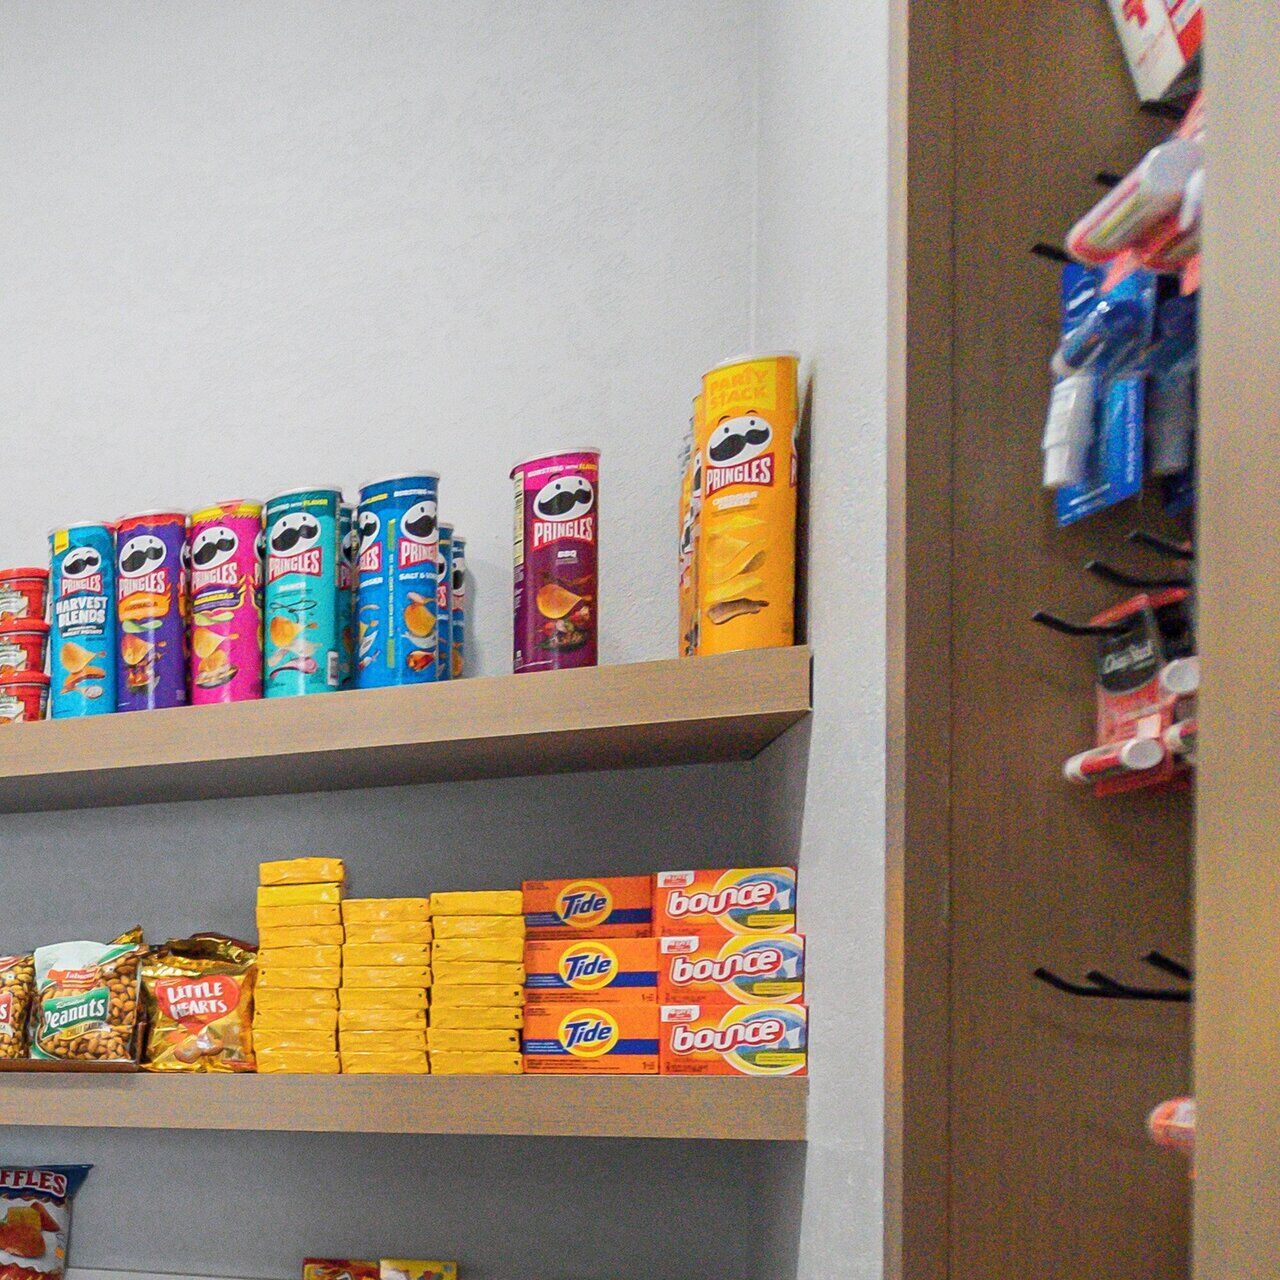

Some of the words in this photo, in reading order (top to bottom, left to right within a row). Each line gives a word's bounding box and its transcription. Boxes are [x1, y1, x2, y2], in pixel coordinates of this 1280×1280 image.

[707, 457, 771, 494] PRINGLES
[534, 518, 593, 546] PRINGLES
[192, 564, 237, 587] PRINGLES
[269, 550, 321, 574] PRINGLES
[62, 577, 102, 593] PRINGLES
[118, 572, 165, 594] PRINGLES
[57, 596, 107, 614] HARVEST
[59, 609, 105, 624] BLENDS
[562, 893, 607, 920] Tide
[669, 884, 773, 916] bounce
[565, 954, 611, 982] Tide
[672, 951, 778, 982] bounce
[167, 982, 223, 1001] LITTLE
[45, 999, 104, 1032] Peanuts
[171, 1000, 228, 1020] HEARTS
[565, 1020, 611, 1048] Tide
[673, 1022, 781, 1053] bounce
